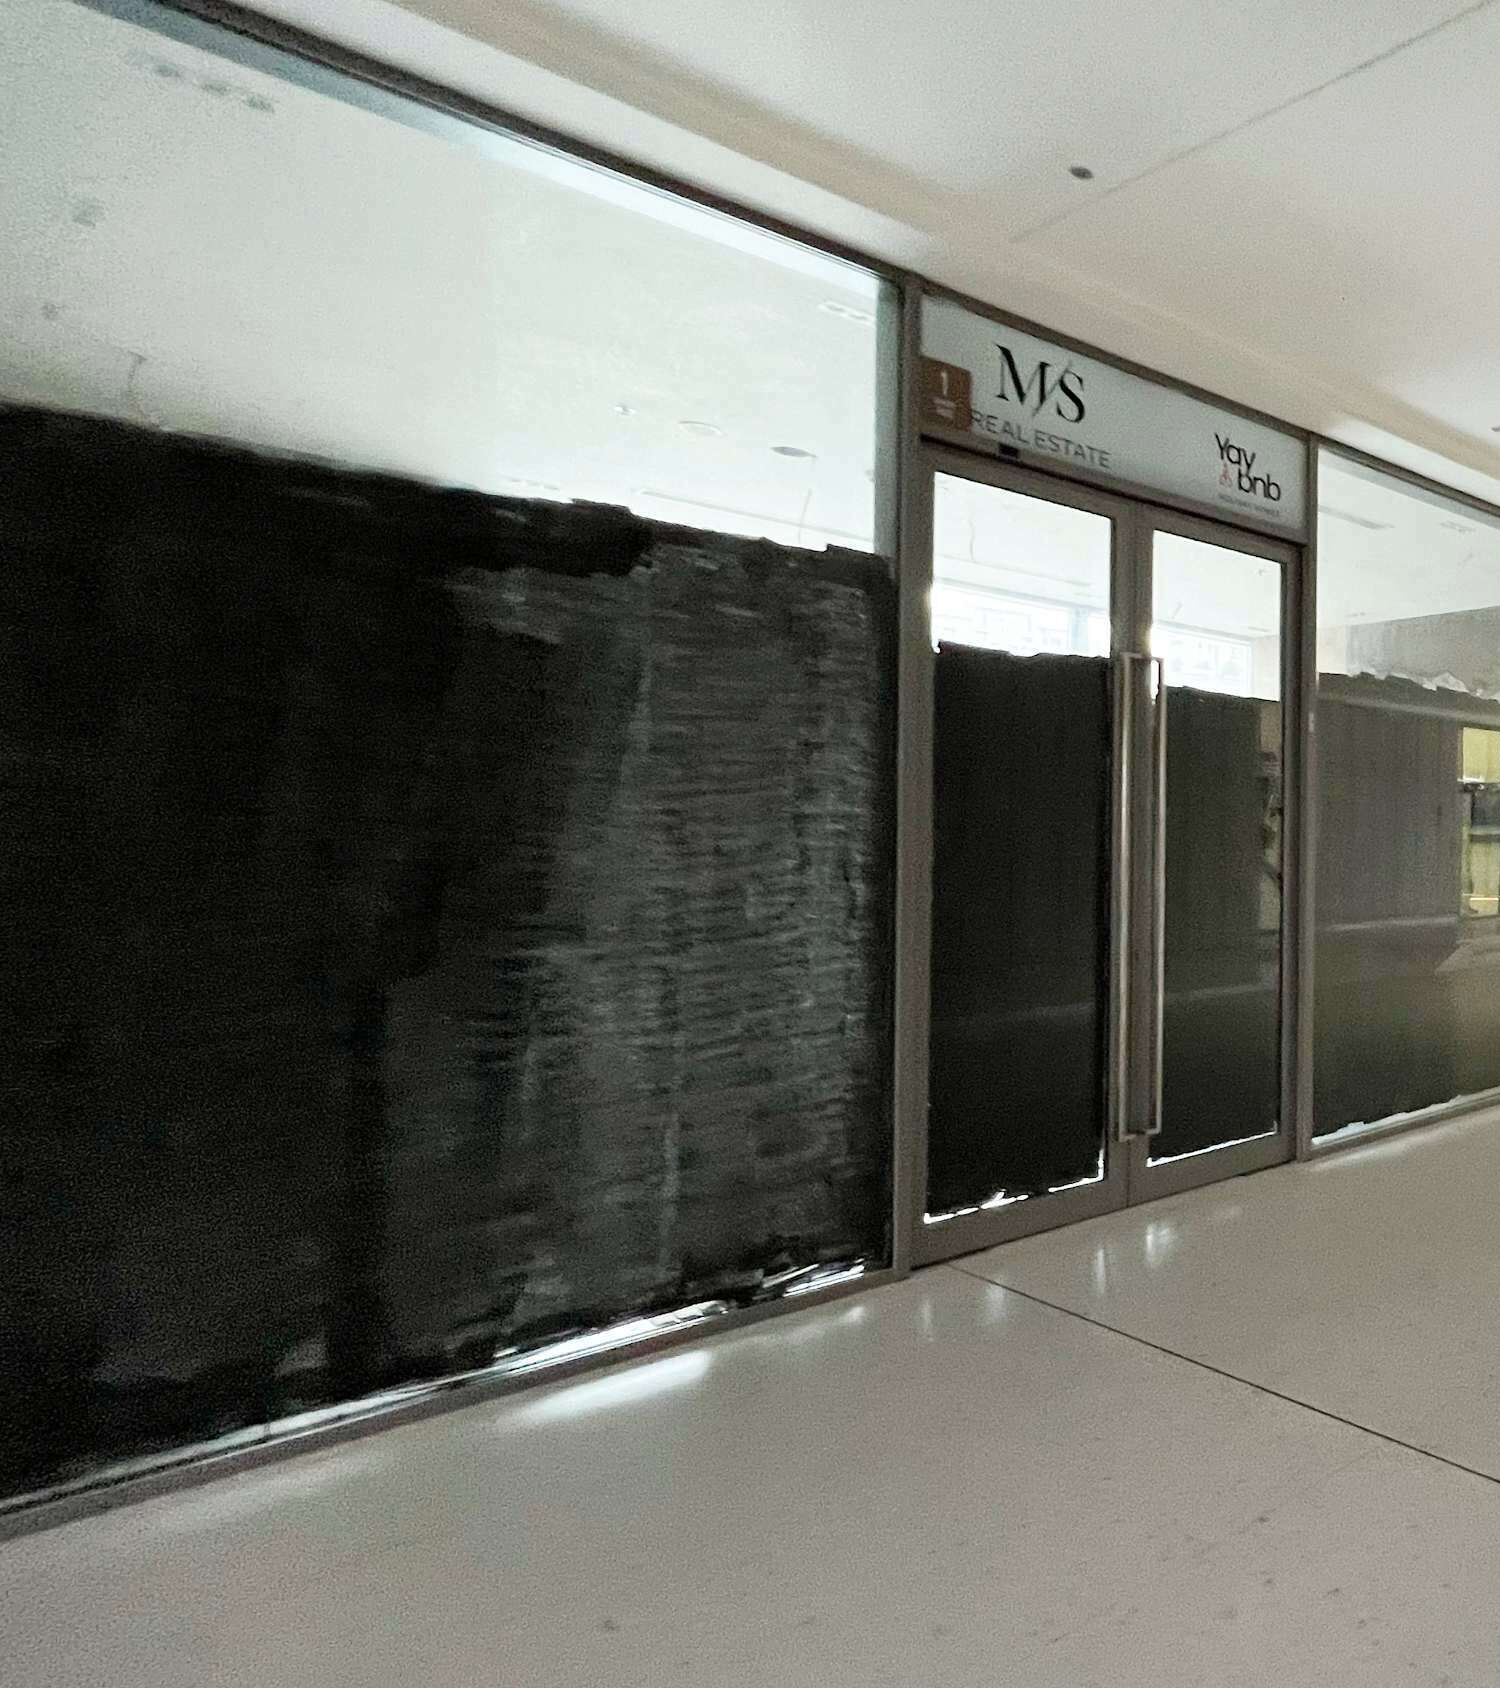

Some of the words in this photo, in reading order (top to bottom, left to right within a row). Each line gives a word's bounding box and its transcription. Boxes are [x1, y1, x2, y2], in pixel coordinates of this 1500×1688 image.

[971, 409, 1030, 446] REAL
[1034, 428, 1111, 470] ESTATE
[1214, 432, 1257, 475] Yay
[1238, 468, 1282, 502] bnb
